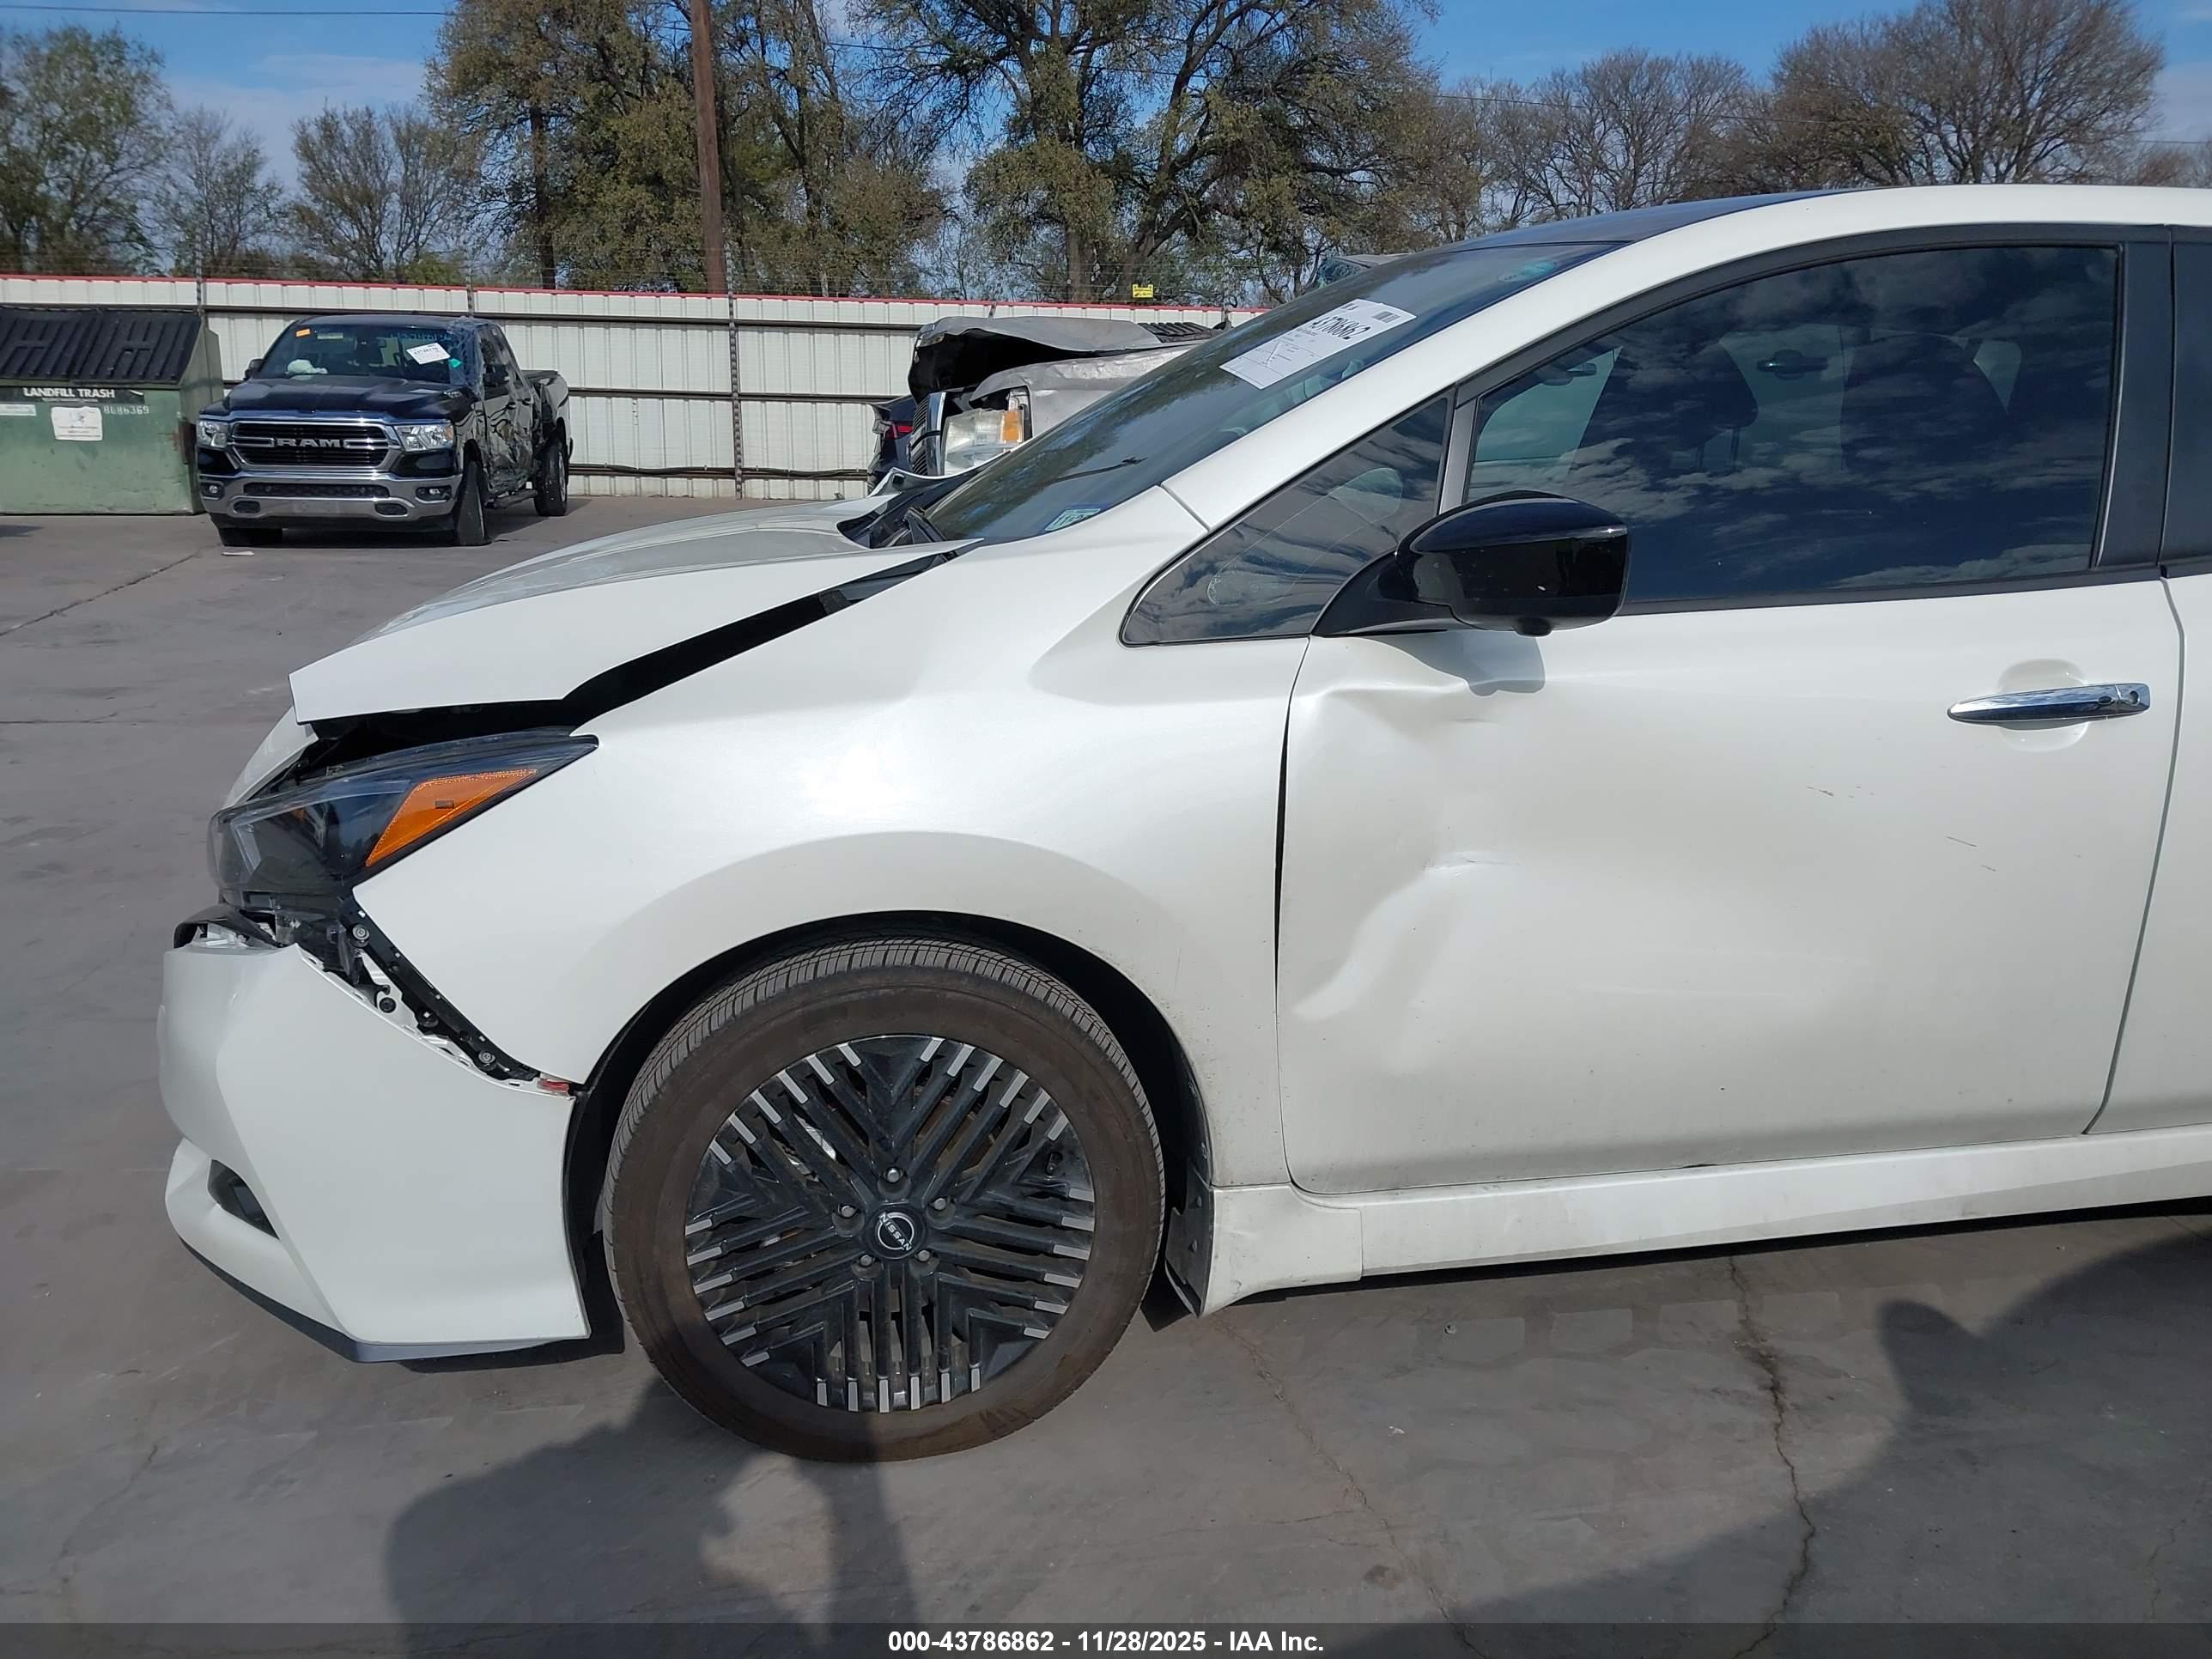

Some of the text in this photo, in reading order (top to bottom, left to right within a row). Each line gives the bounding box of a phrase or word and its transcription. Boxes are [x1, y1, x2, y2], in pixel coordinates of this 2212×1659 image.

[22, 387, 115, 398] LANDFILL TRASH
[276, 438, 341, 447] RAM
[878, 1212, 912, 1251] NISSAN
